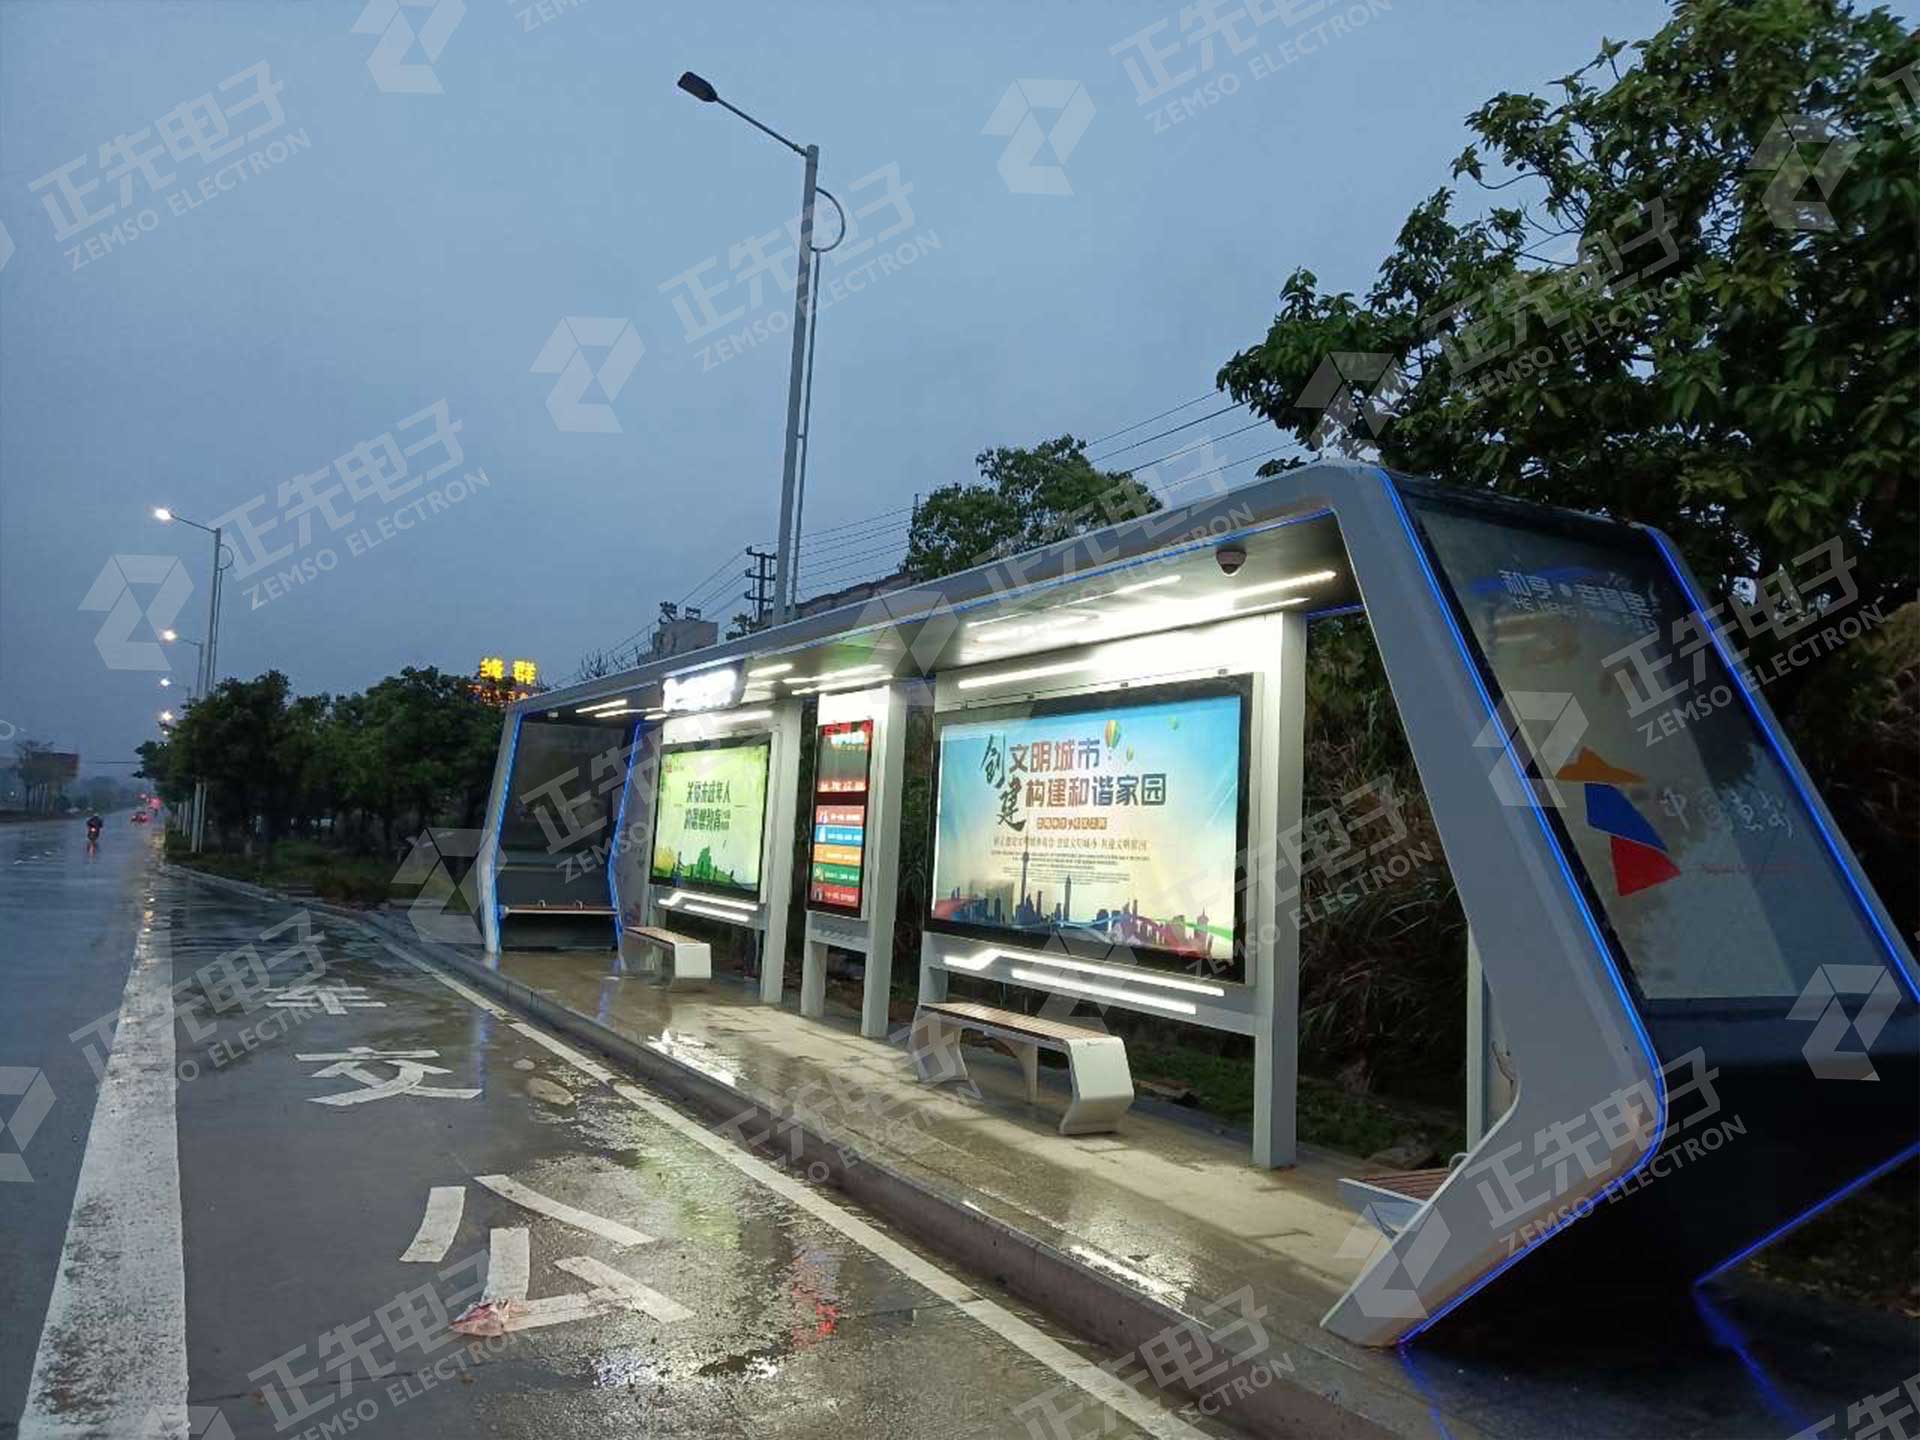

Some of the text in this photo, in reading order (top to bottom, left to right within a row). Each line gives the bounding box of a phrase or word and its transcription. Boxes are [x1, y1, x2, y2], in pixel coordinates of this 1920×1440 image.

[1009, 738, 1100, 773] 文明城市
[1024, 773, 1167, 808] 构建和谐家园
